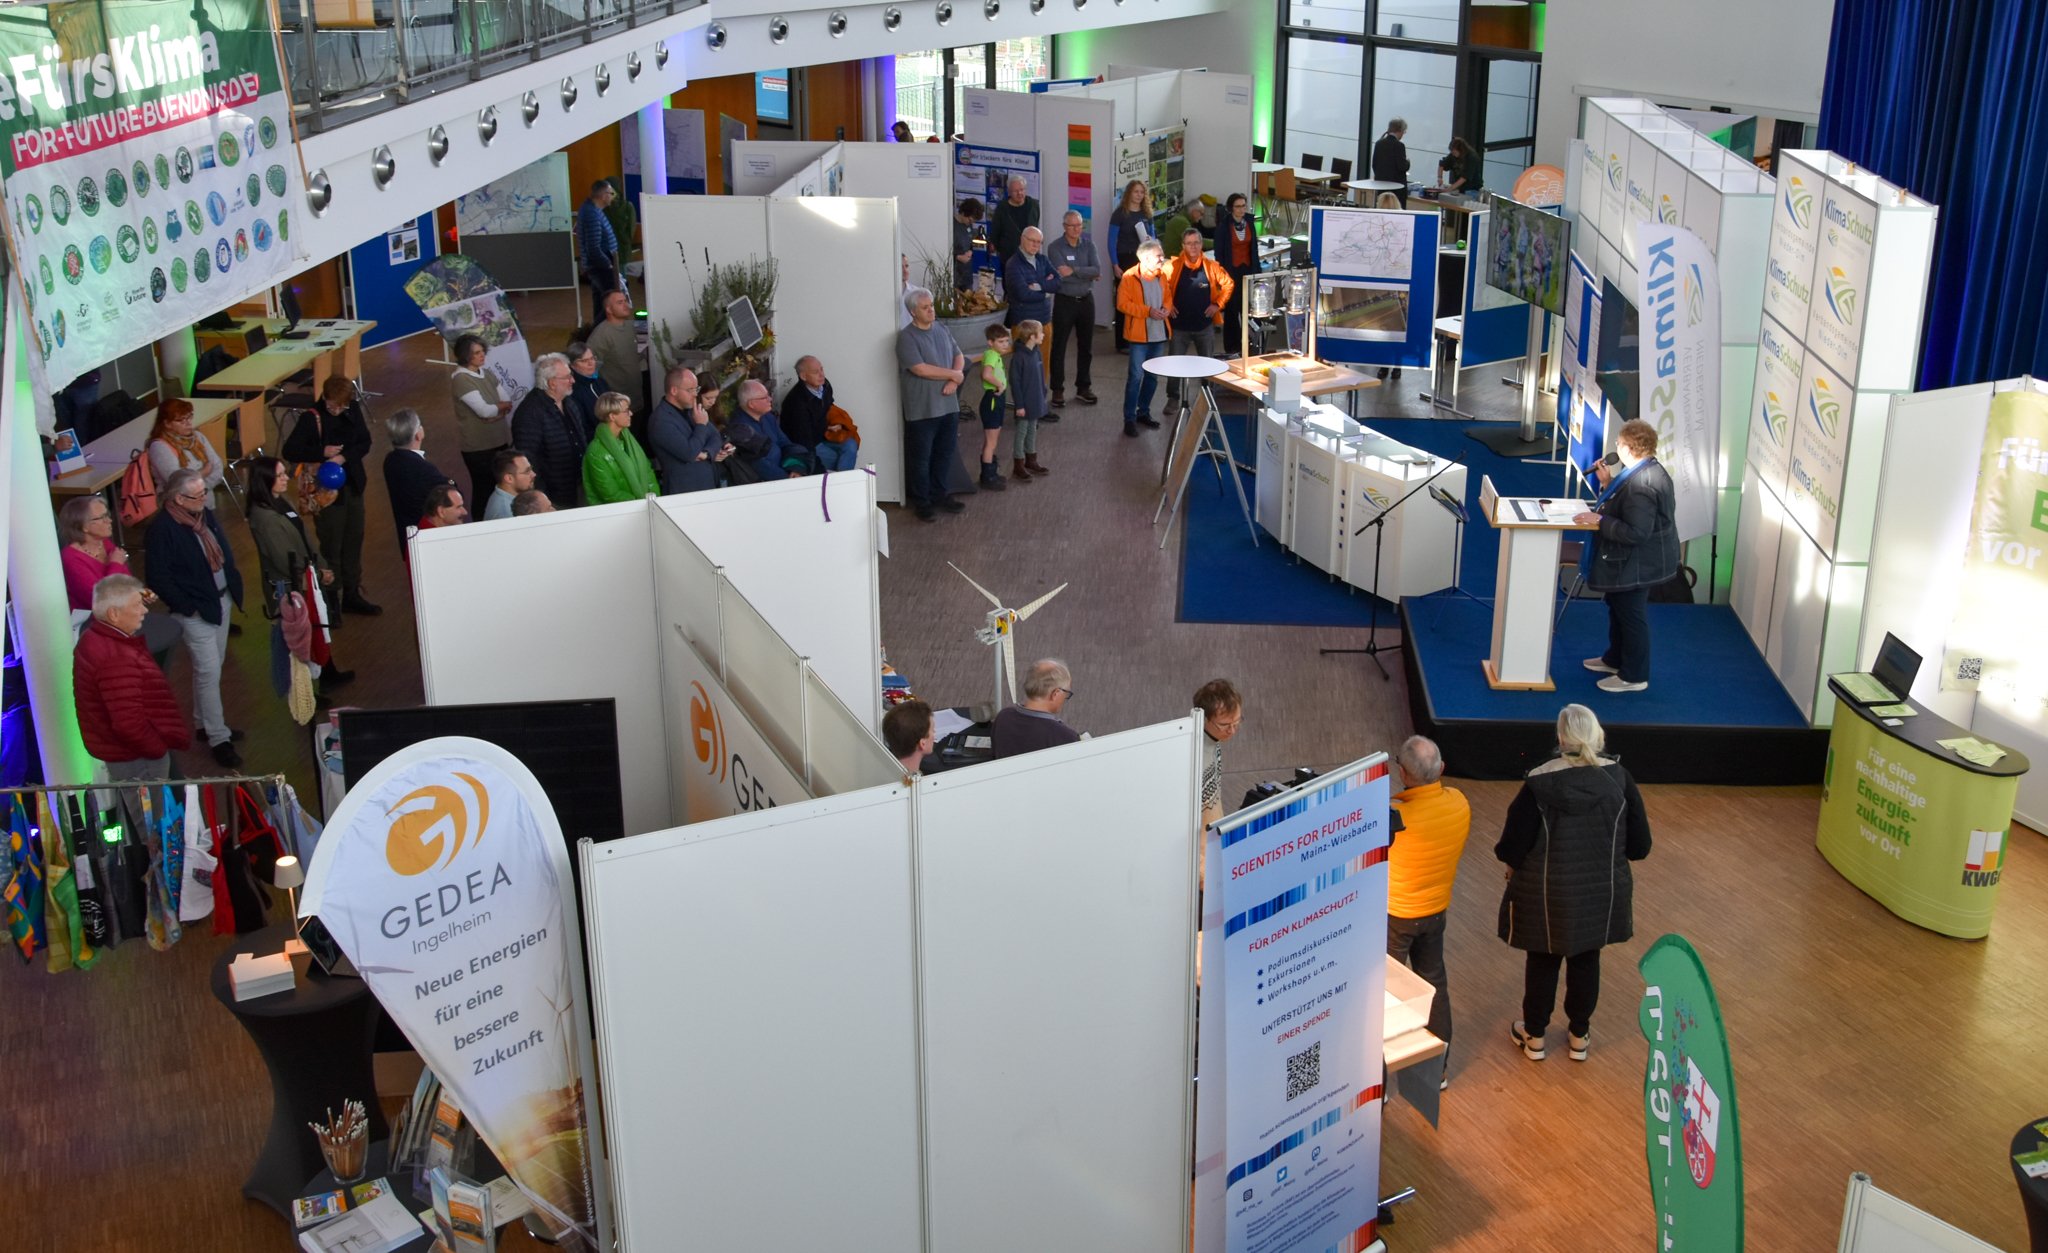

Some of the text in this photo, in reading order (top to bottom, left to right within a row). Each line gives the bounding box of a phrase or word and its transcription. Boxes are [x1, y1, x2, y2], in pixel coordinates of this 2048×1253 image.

[1118, 158, 1147, 175] Garten
[1824, 197, 1873, 245] KlimaSchutz
[1769, 257, 1809, 304] KlimaSchutz
[1761, 327, 1801, 378] KlimaSchutz
[1791, 455, 1836, 519] KlimaSchutz
[1981, 539, 2042, 571] vor
[1855, 759, 1927, 808] nachhaltige
[1868, 746, 1917, 785] Für eine
[1857, 777, 1917, 823] Energie-
[1231, 808, 1363, 881] SCIENTISTS FOR FUTURE
[1300, 819, 1378, 863] Mainz-Wiesbaden
[1856, 802, 1911, 847] zukunft
[1859, 823, 1902, 860] vor Ort
[380, 861, 512, 939] GEDEA
[412, 910, 492, 955] Ingelheim
[1249, 934, 1269, 953] FÜR
[1271, 925, 1290, 942] DEN
[1268, 923, 1352, 973] Podiumsdiskussionen
[414, 926, 548, 1000] Neue Energien
[1268, 955, 1316, 987] Exkursionen
[434, 982, 504, 1025] für eine
[1262, 981, 1348, 1036] UNTERSTÜTZT UNS MIT
[1268, 973, 1312, 1002] Workshops
[453, 1009, 519, 1051] bessere
[1277, 1008, 1331, 1044] EINER SPENDE
[472, 1028, 545, 1076] Zukunft
